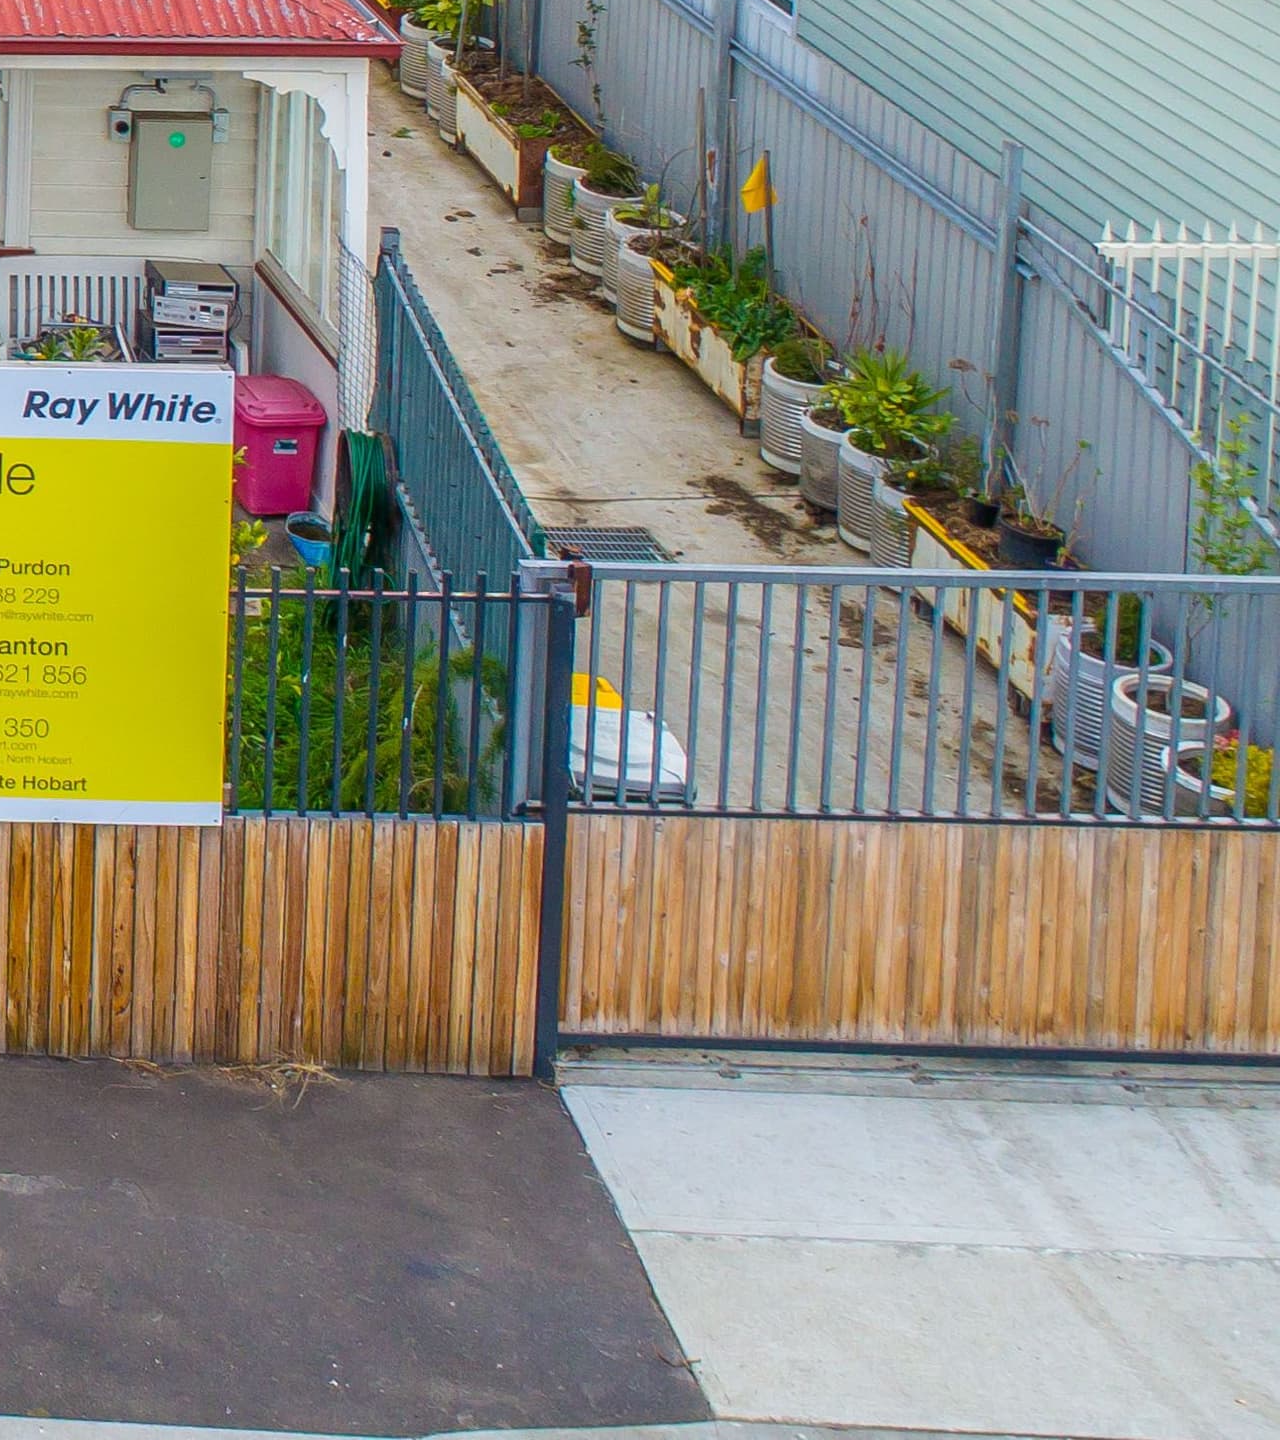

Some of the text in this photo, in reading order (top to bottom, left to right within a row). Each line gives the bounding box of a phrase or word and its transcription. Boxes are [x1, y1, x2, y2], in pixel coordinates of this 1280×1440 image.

[22, 389, 217, 426] Ray White
[22, 587, 60, 605] 229
[42, 664, 88, 685] 856
[22, 774, 88, 792] Hobart
